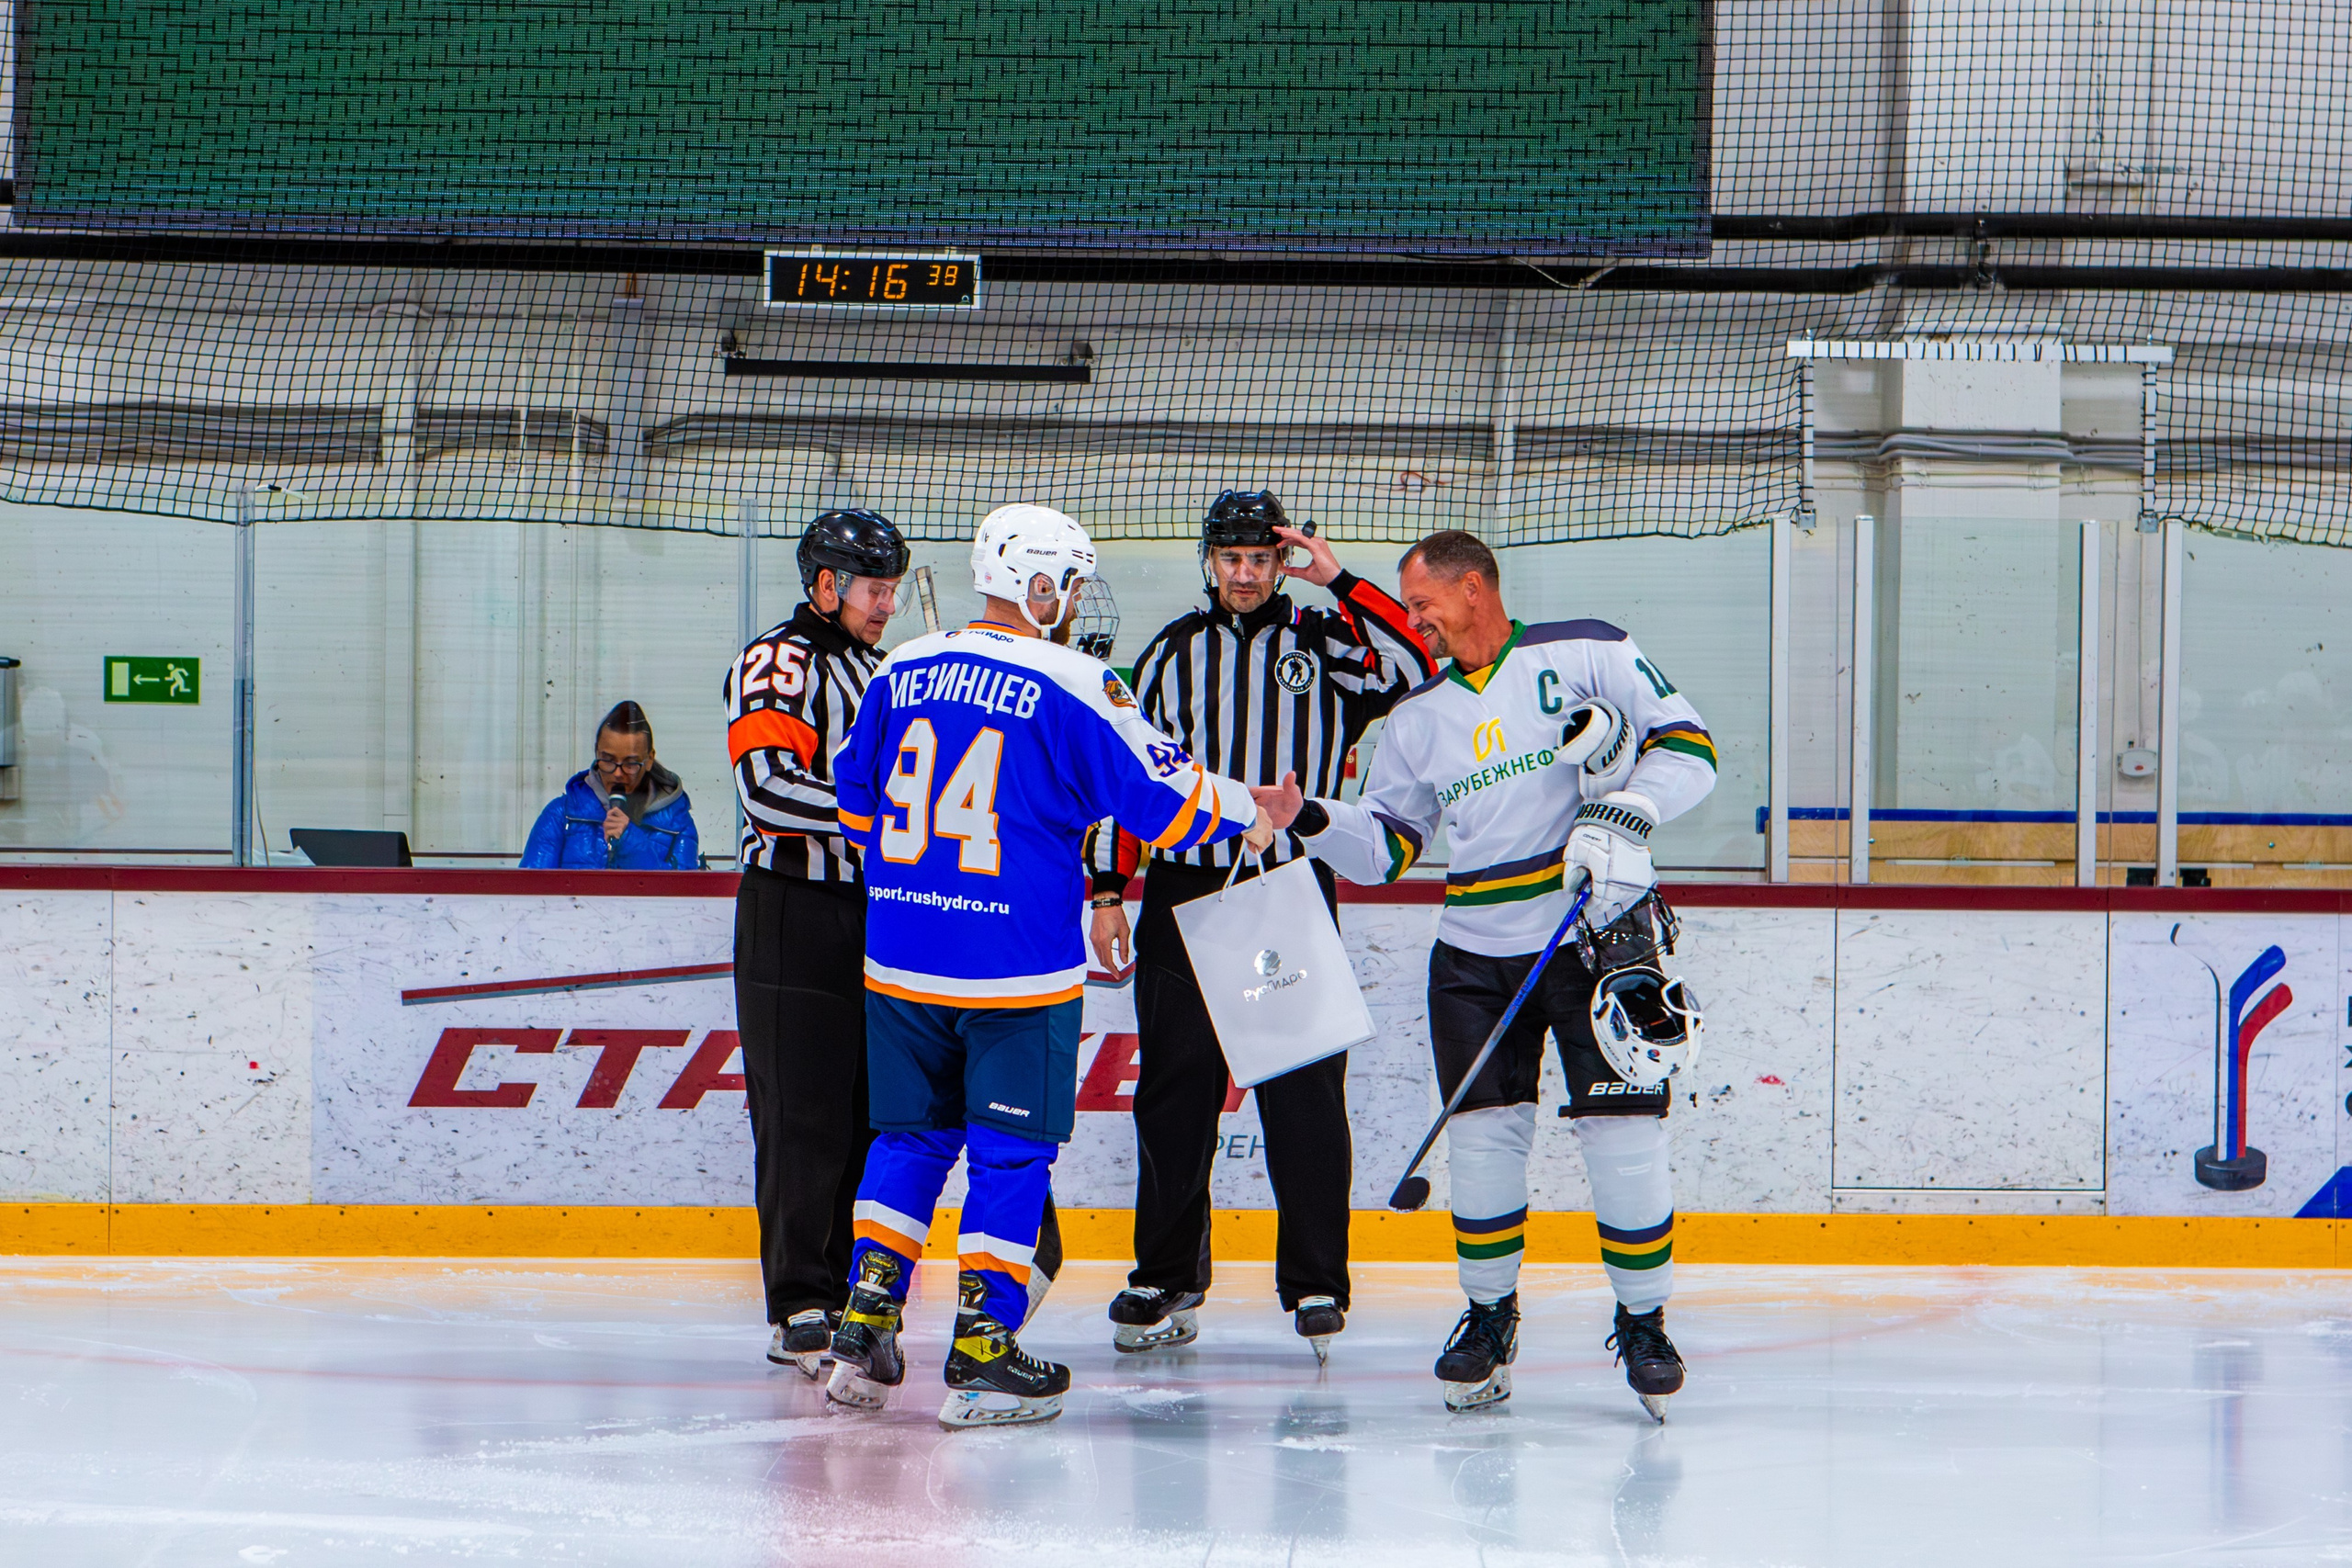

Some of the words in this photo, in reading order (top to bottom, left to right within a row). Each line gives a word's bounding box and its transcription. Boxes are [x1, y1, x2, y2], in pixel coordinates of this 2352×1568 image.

[797, 264, 909, 299] 14:16
[926, 265, 959, 286] 38
[741, 642, 807, 698] 25
[1537, 669, 1563, 715] C
[1146, 740, 1195, 778] 94
[879, 717, 1004, 877] 94
[868, 885, 1010, 915] sport.rushydro.ru
[989, 1101, 1031, 1118] BAUER
